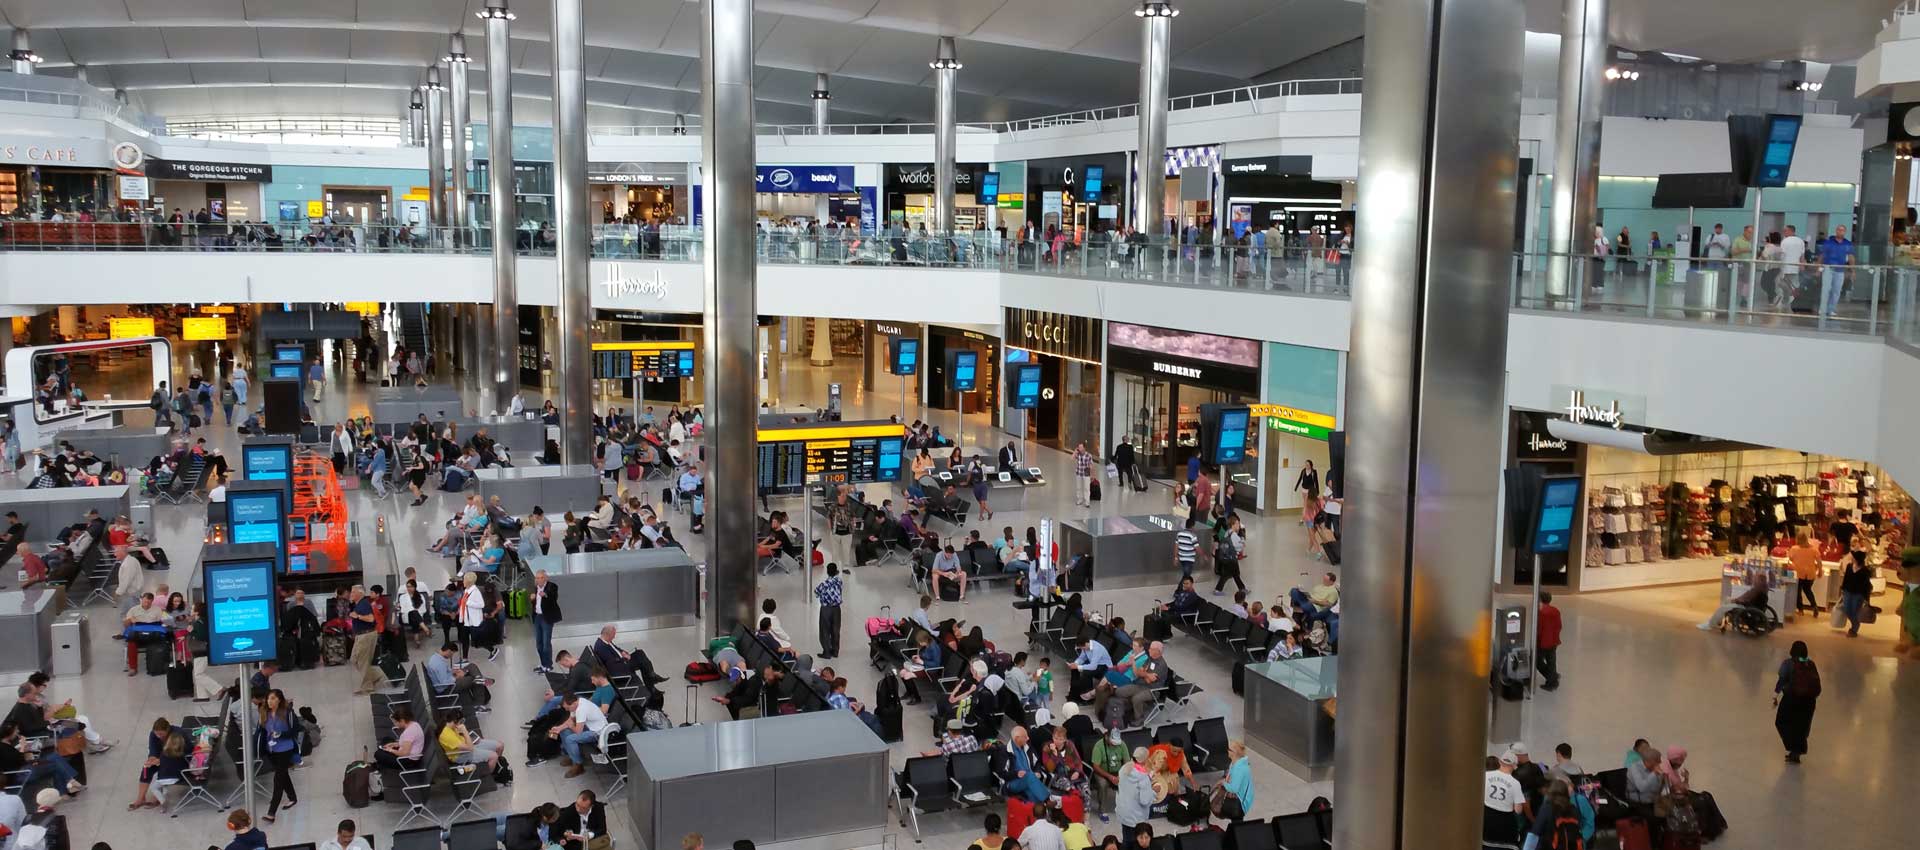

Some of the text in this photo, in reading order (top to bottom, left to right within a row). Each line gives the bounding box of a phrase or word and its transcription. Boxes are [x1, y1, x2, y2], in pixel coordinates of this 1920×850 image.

[189, 164, 230, 173] GORGEOUS
[232, 166, 263, 174] KITCHEN
[1231, 164, 1249, 173] Currency
[811, 173, 837, 183] beauty
[1314, 213, 1328, 221] ATM
[600, 263, 668, 301] Harrods
[876, 323, 902, 336] BVLGARI
[1024, 320, 1067, 344] GUCCI
[1153, 361, 1202, 379] BURBERRY
[1565, 389, 1622, 430] Harrods
[1278, 420, 1301, 433] Emergency
[1527, 432, 1567, 451] Harrods
[1489, 784, 1506, 801] 23
